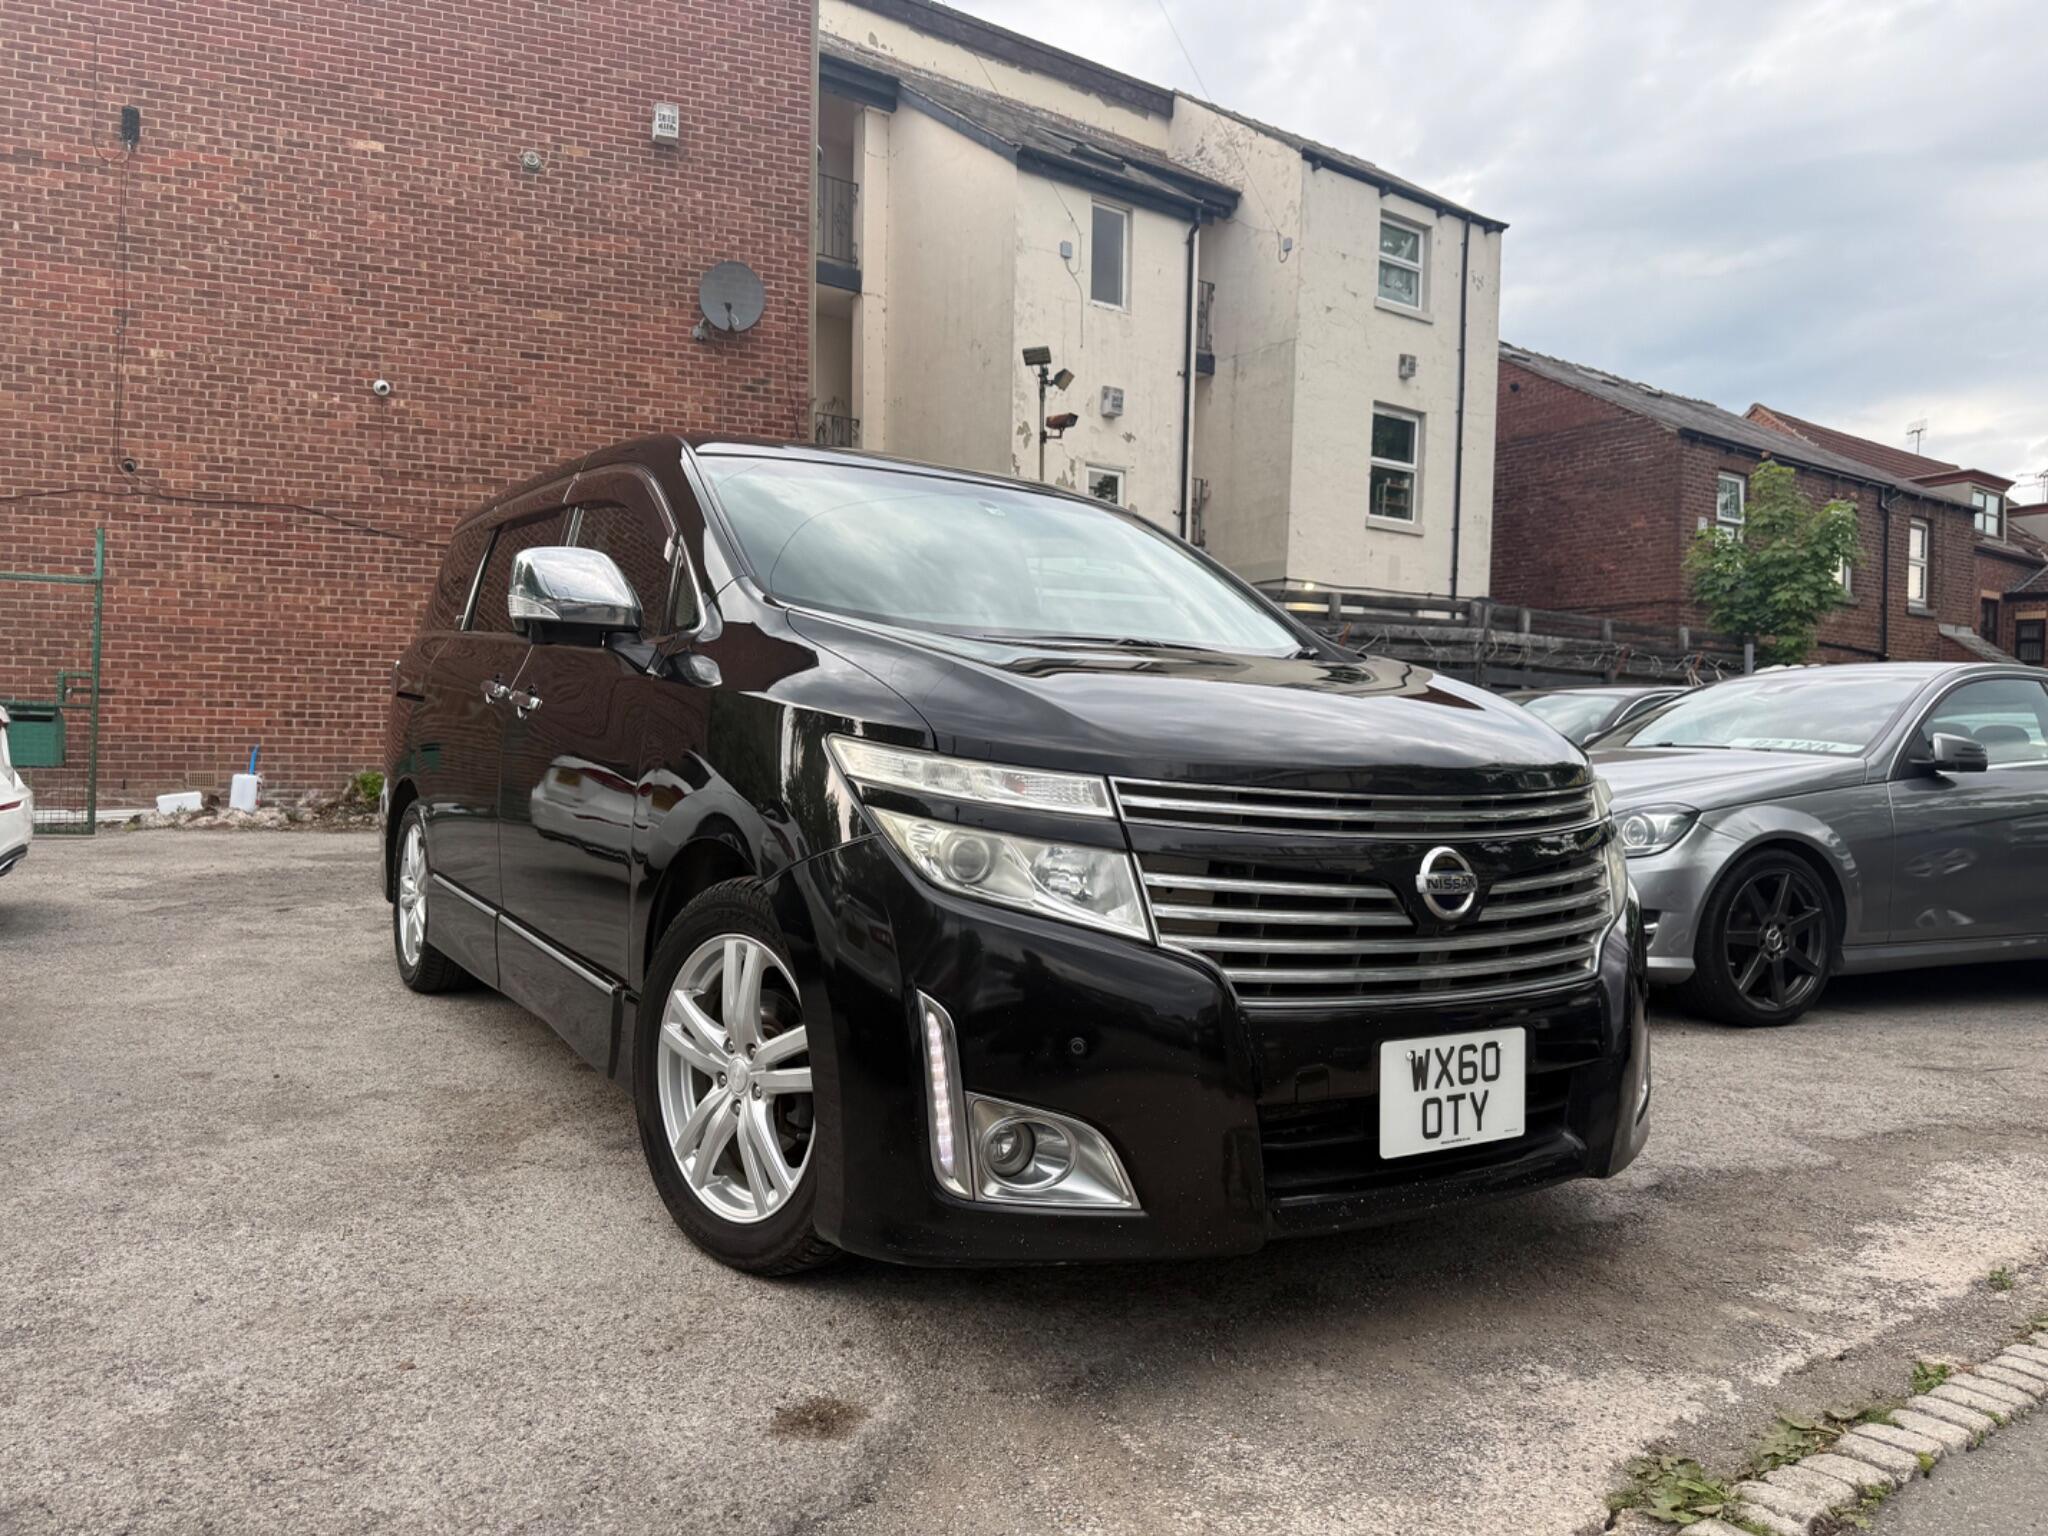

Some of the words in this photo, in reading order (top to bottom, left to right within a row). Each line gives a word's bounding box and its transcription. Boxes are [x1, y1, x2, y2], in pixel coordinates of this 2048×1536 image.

[1426, 877, 1475, 890] NISSAN
[1410, 1041, 1500, 1092] WX60
[1422, 1089, 1489, 1139] OTY
